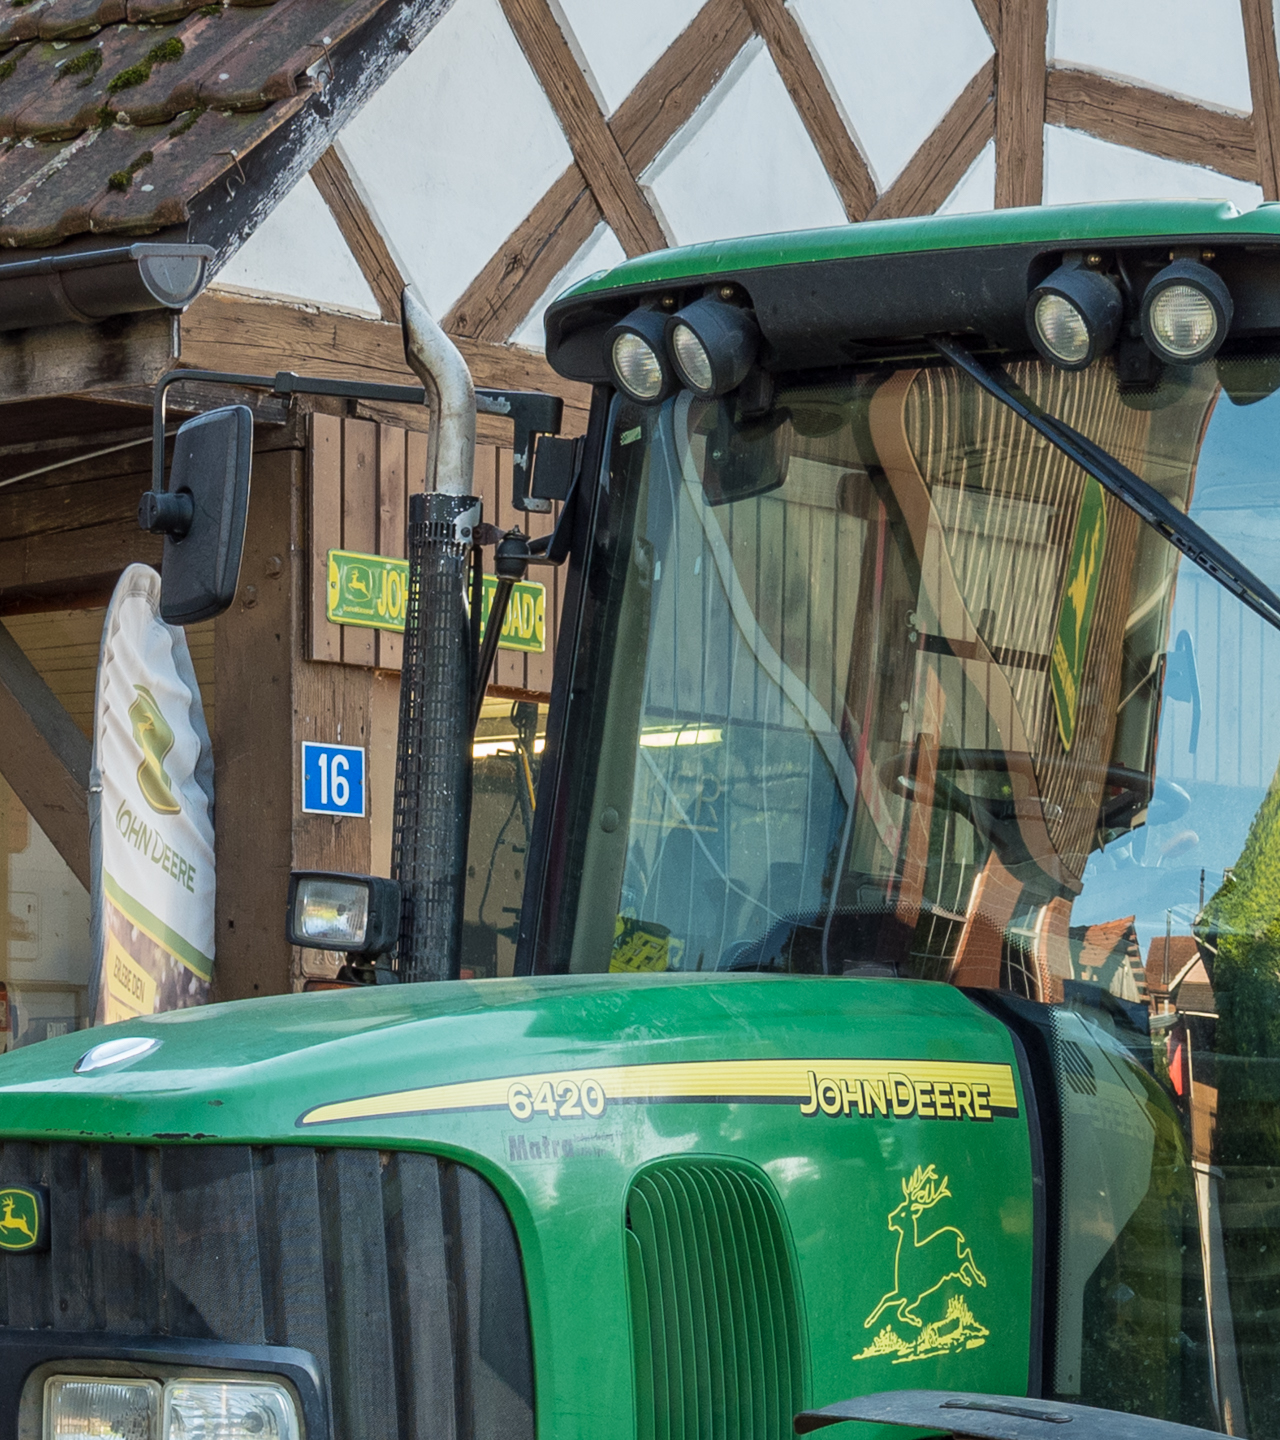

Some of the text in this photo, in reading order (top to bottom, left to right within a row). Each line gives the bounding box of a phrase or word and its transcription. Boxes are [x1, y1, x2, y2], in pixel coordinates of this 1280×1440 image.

[318, 753, 349, 806] 16
[116, 799, 197, 894] JOHN DEERE
[131, 973, 146, 1003] DEN
[507, 1078, 607, 1123] 6420
[800, 1070, 992, 1122] JOHN DEERE
[508, 1134, 575, 1162] Matra
